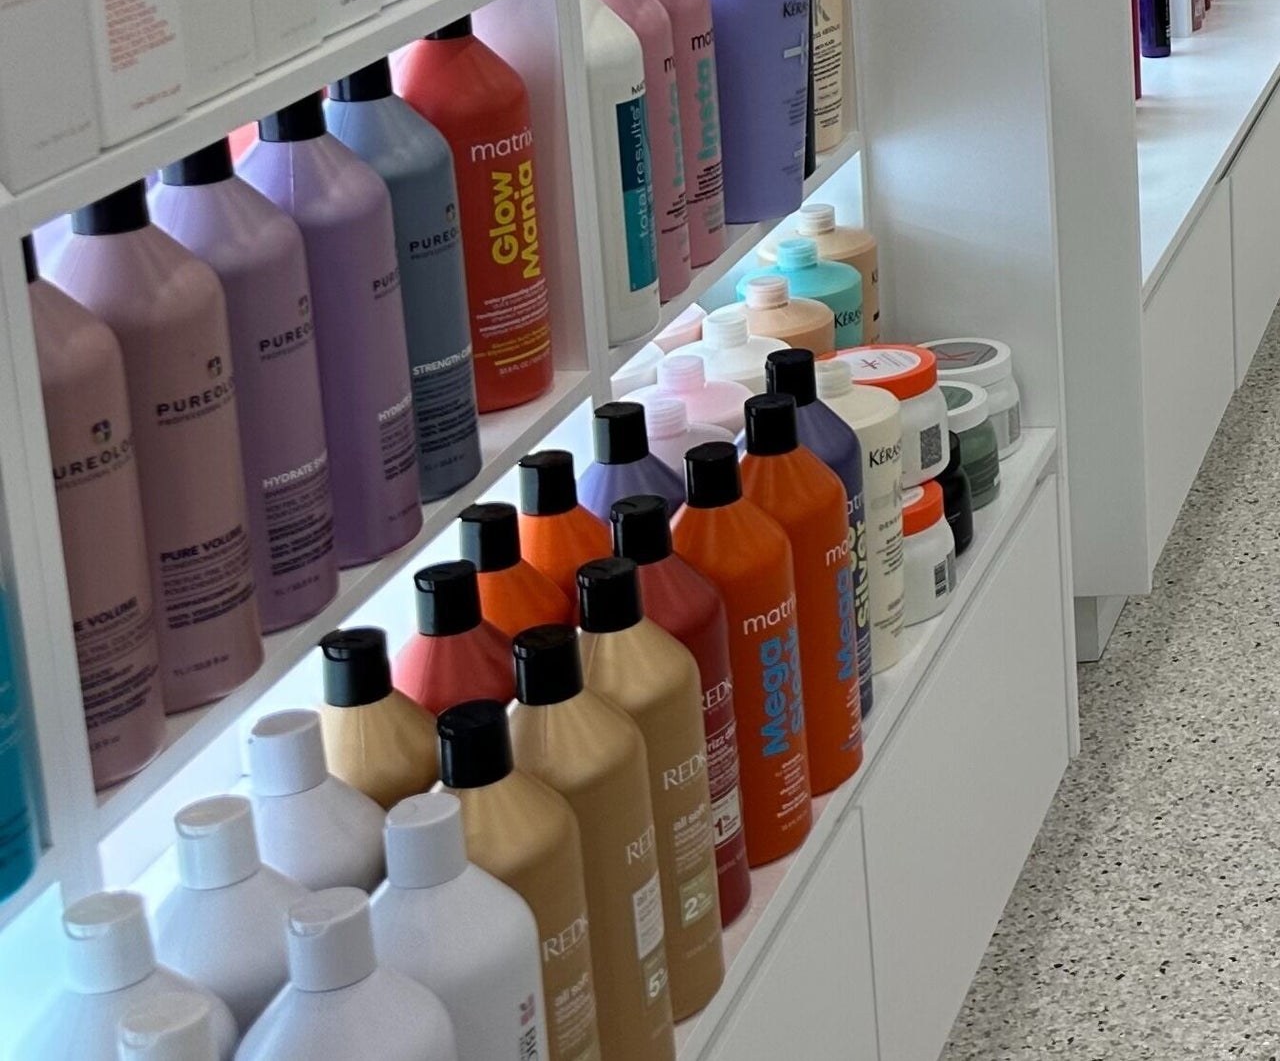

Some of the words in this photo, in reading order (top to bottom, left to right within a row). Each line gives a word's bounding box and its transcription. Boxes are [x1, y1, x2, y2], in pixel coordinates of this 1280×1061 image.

[489, 171, 519, 265] Glow
[514, 160, 541, 279] Mania
[637, 188, 649, 238] total
[413, 353, 460, 376] STRENGTH
[263, 464, 313, 488] HYDRATE
[160, 545, 199, 563] PURE
[837, 567, 854, 680] Mega
[760, 637, 789, 758] Mega
[707, 734, 726, 753] rizz
